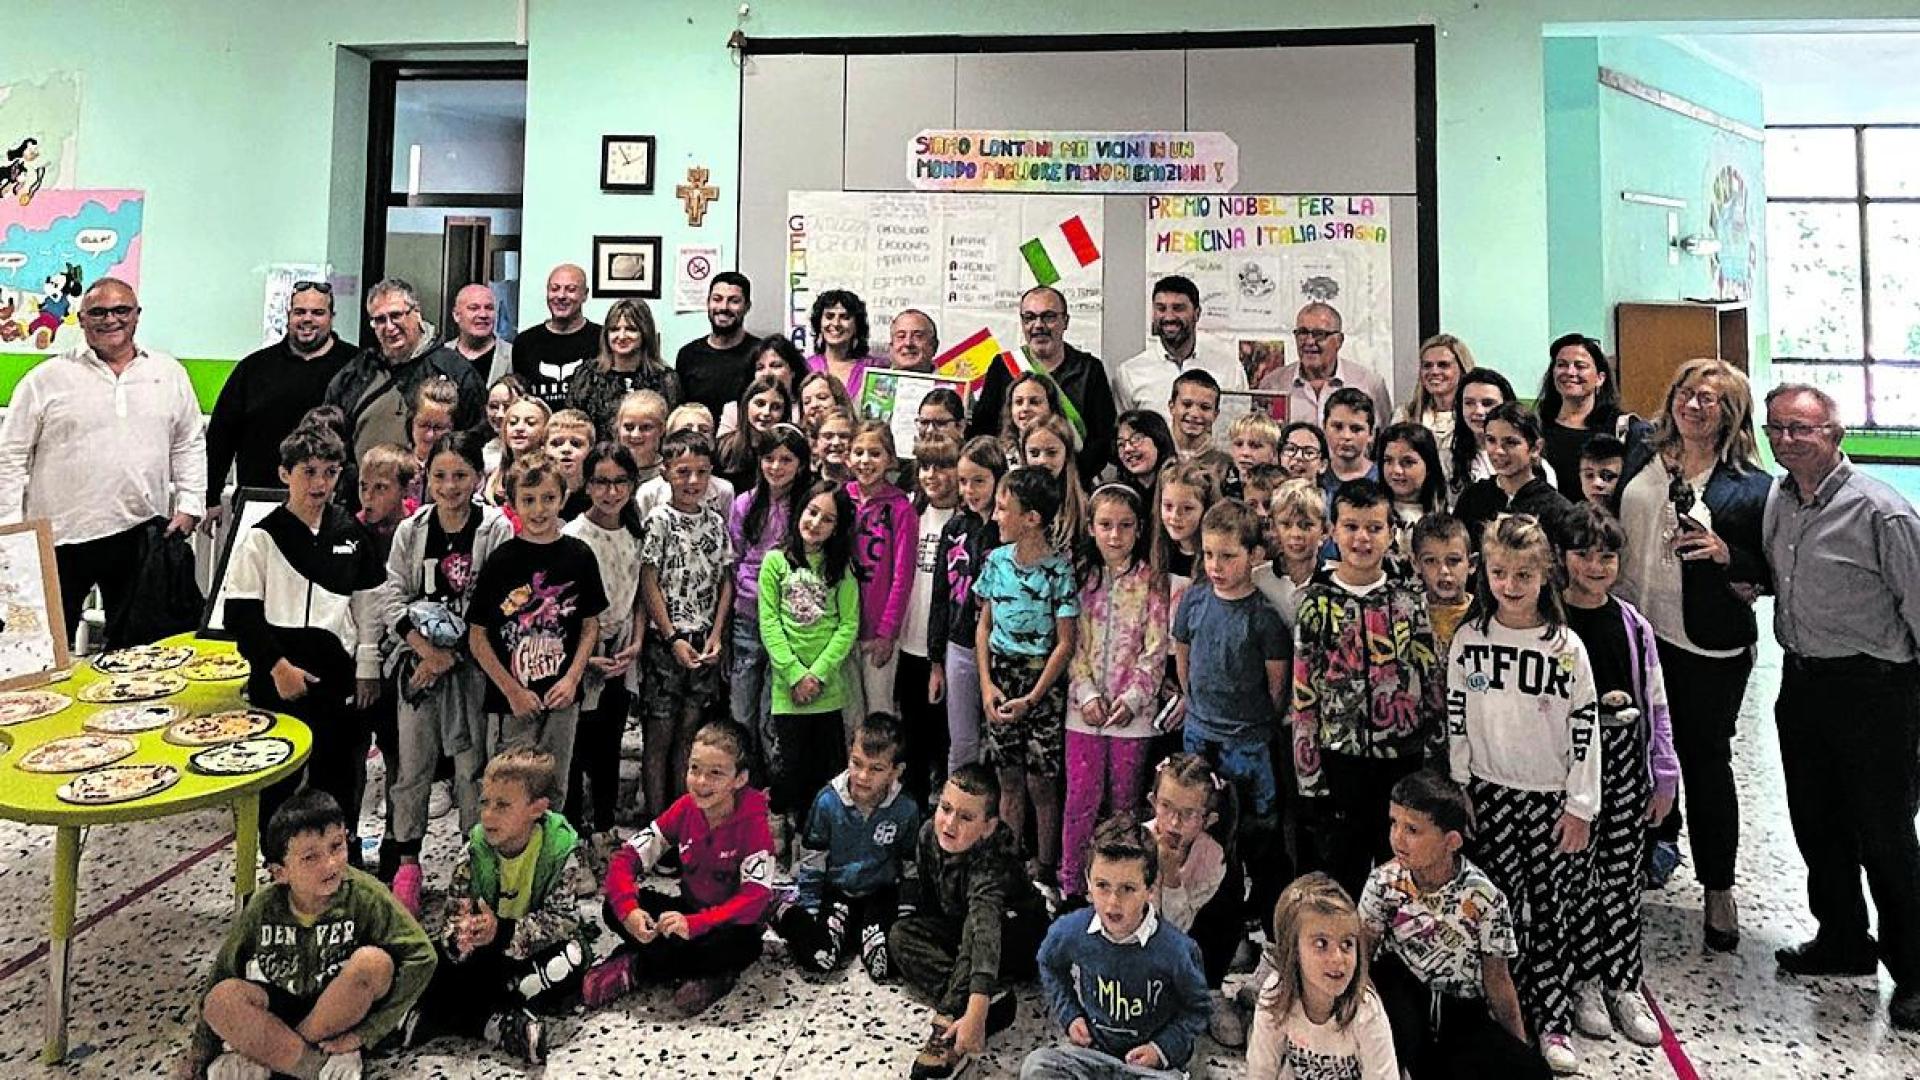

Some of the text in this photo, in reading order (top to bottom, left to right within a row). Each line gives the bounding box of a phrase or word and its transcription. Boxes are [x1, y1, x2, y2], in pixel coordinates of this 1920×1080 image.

[916, 136, 971, 155] SIAMO
[979, 138, 1053, 158] LONTANI
[1096, 140, 1145, 159] VICINI
[1169, 141, 1195, 159] UN
[916, 159, 977, 179] MONDO
[982, 161, 1063, 182] MIGLIORE
[1065, 162, 1112, 182] PIENO
[1132, 163, 1206, 183] EMOZIONI
[1149, 196, 1375, 220] PREMIO NOBEL PER LA
